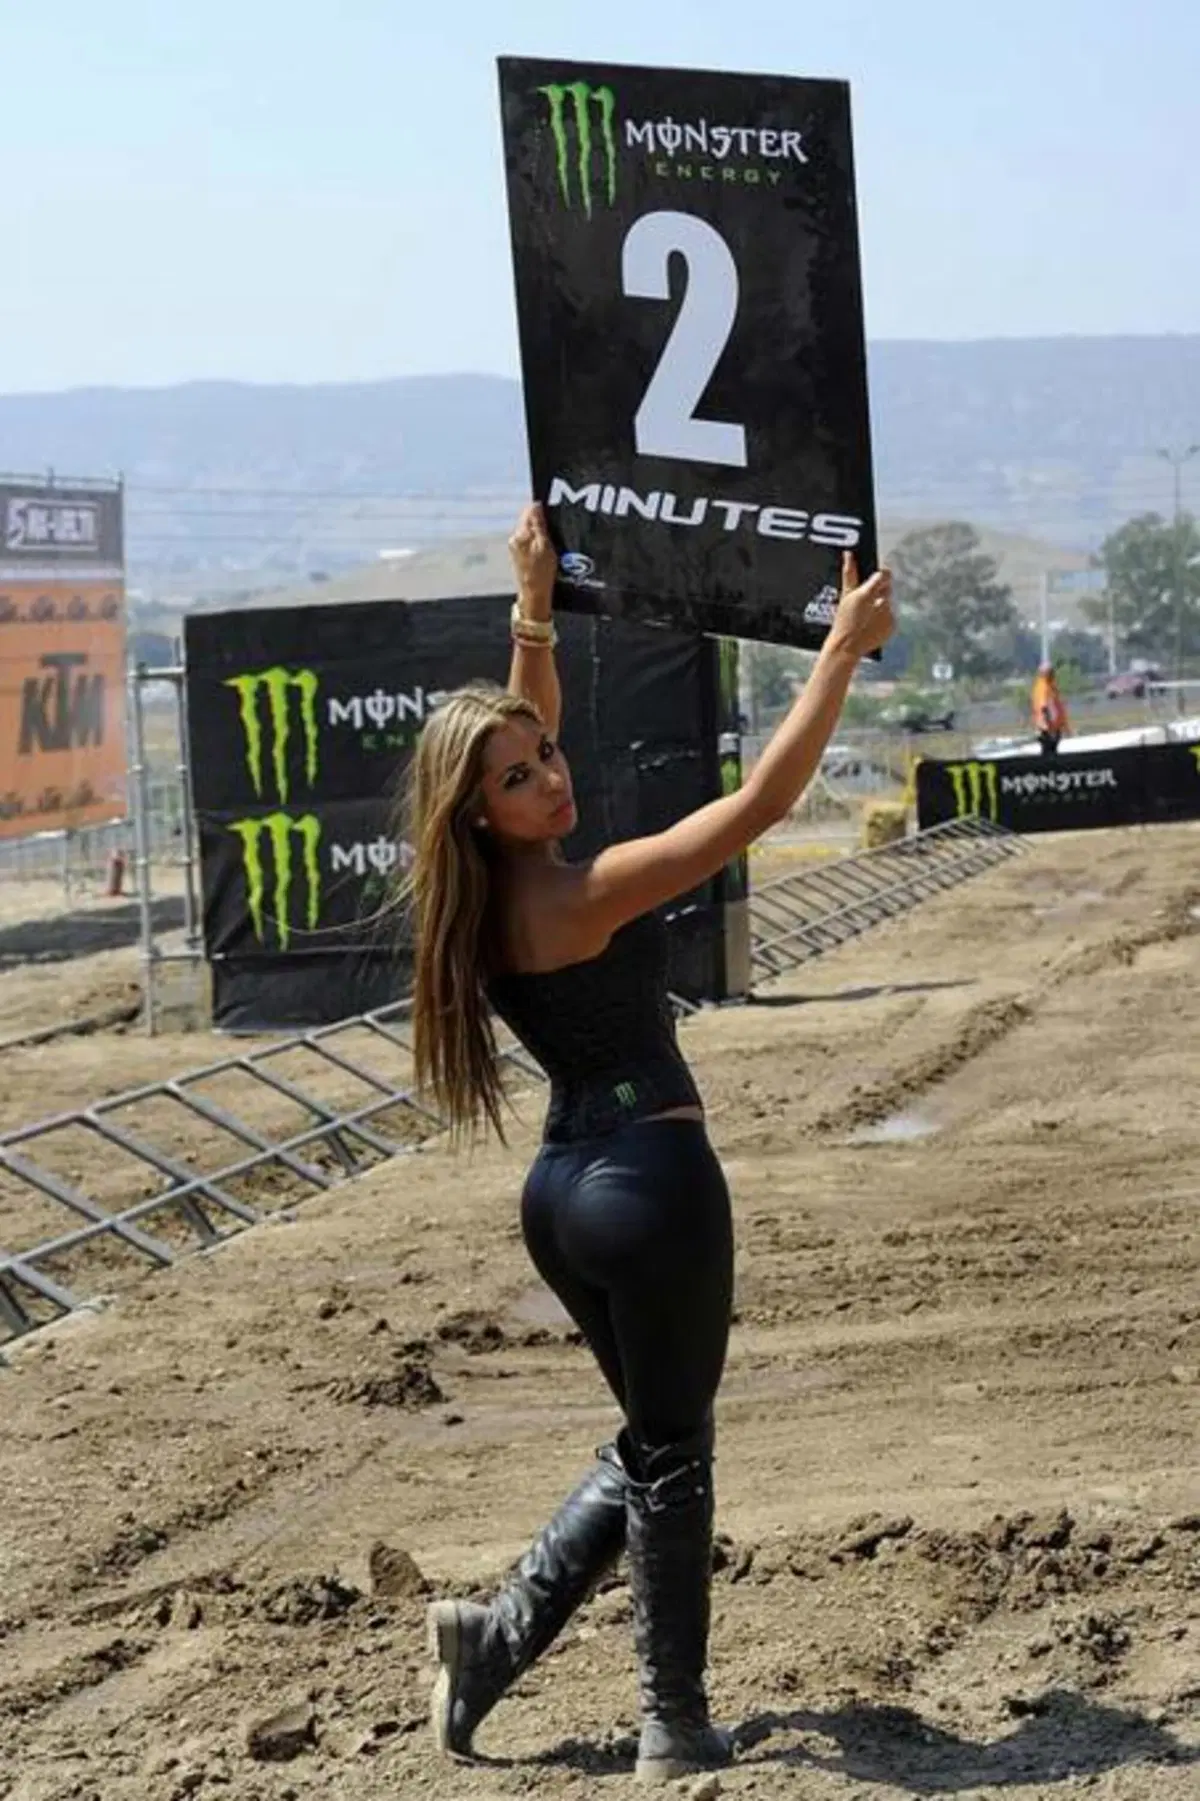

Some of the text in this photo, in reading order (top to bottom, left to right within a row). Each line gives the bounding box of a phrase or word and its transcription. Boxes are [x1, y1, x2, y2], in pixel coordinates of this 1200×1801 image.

[625, 116, 808, 163] MONSTER
[656, 161, 781, 185] ENERGY
[622, 211, 748, 467] 2
[548, 477, 863, 548] MINUTES
[18, 652, 105, 755] KTM
